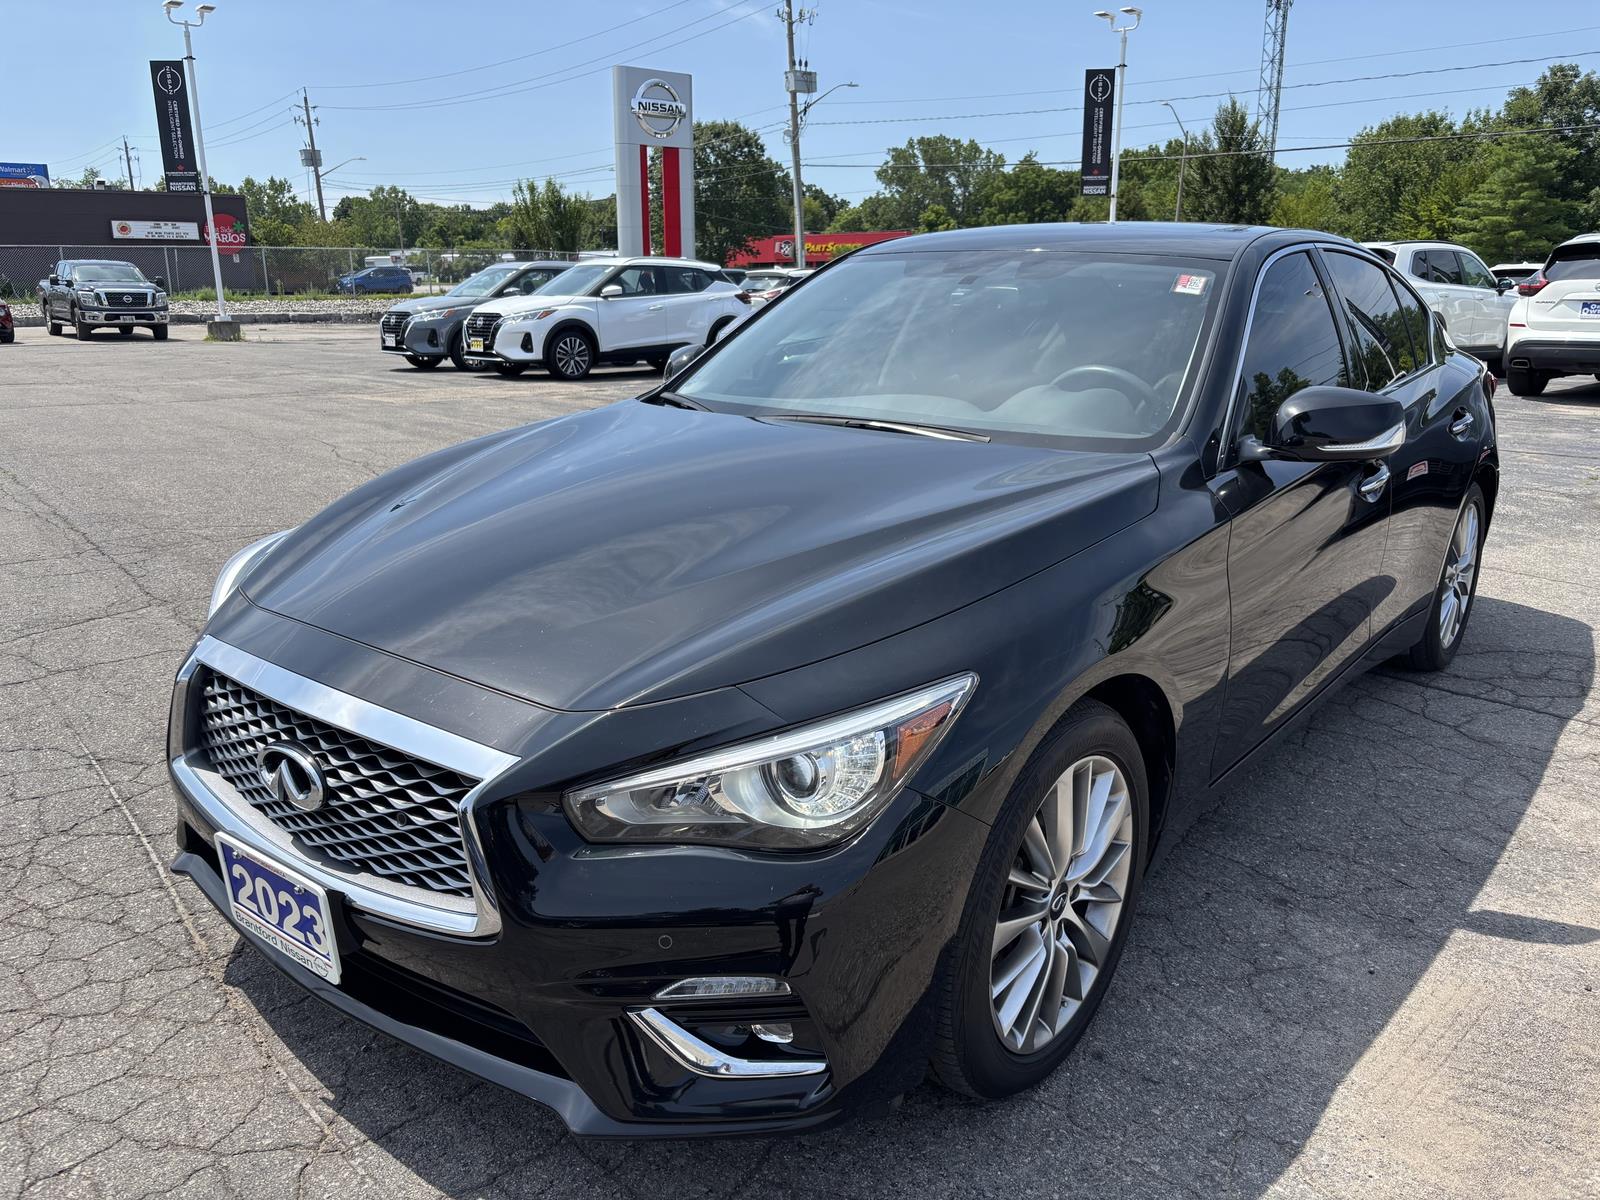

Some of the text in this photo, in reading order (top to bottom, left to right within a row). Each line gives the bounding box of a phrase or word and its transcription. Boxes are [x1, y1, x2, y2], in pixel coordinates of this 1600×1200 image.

[638, 101, 683, 114] NISSAN
[232, 864, 330, 956] 2023
[235, 910, 314, 969] Brantford Nissan
